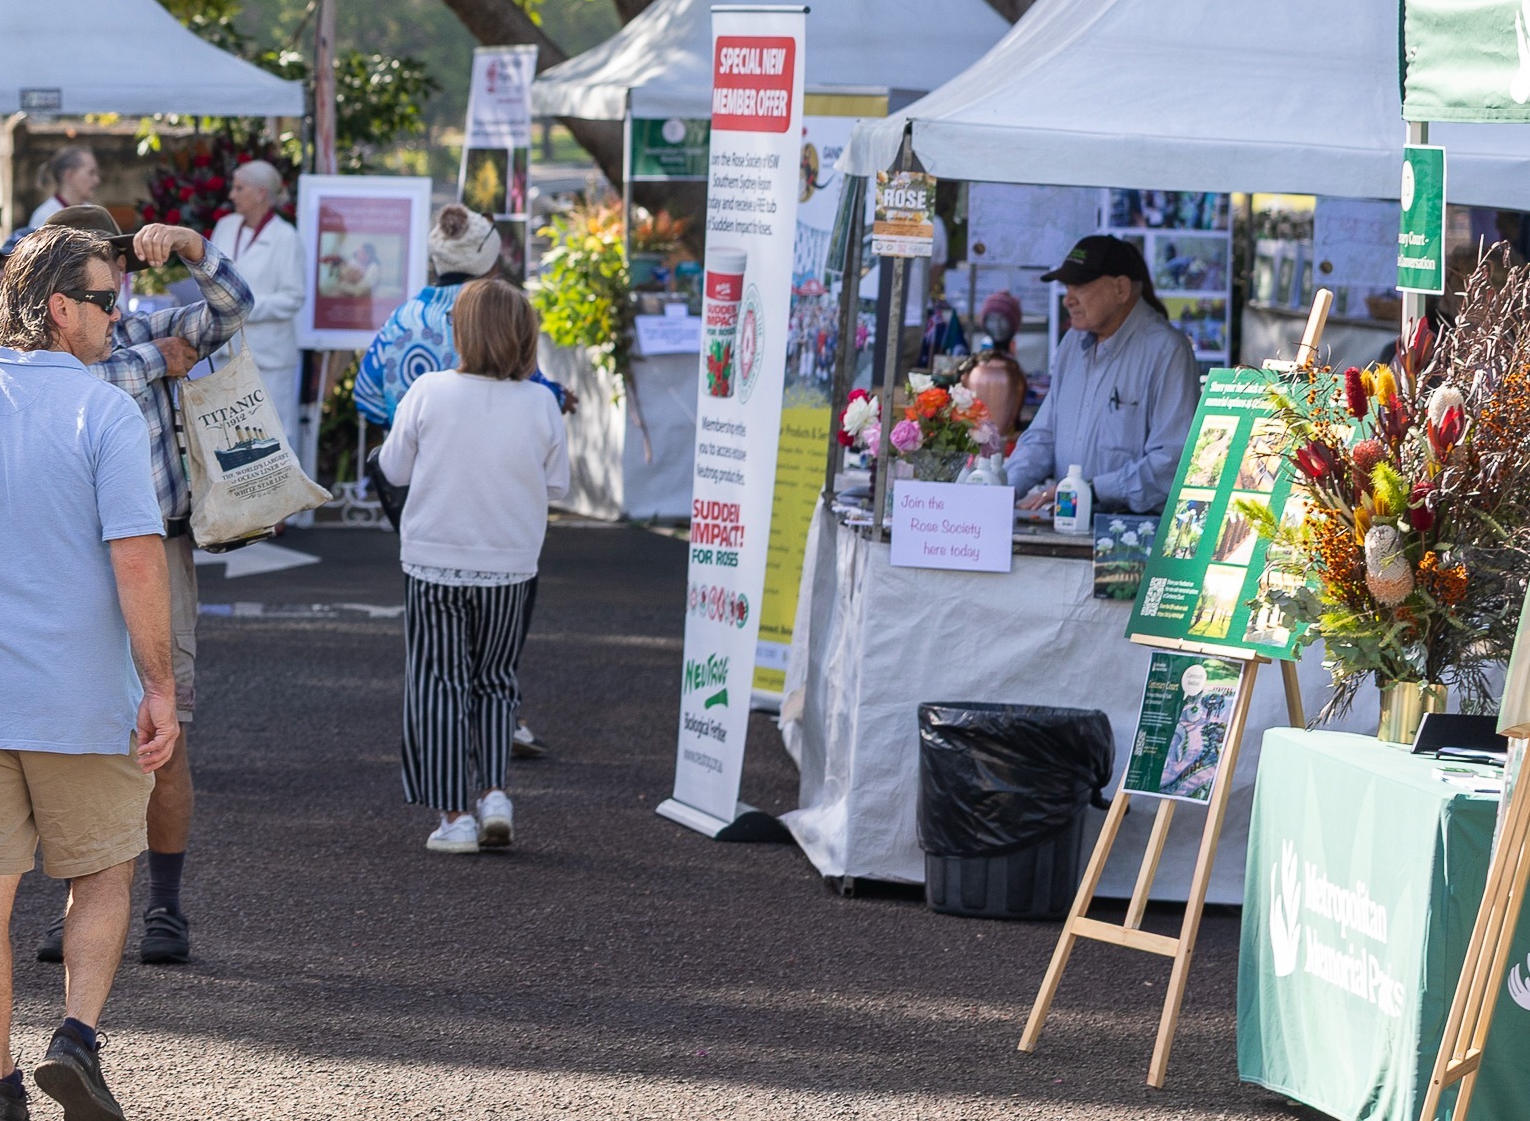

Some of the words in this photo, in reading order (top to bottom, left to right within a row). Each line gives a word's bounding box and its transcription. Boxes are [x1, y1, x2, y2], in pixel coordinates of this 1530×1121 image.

[719, 47, 761, 75] SPECIAL
[762, 47, 787, 76] NEW
[712, 87, 757, 117] MEMBER
[757, 88, 788, 118] OFFER
[721, 152, 731, 167] the
[732, 152, 745, 168] Rose
[712, 172, 738, 189] Southern
[722, 196, 734, 211] and
[884, 188, 927, 210] ROSE
[711, 216, 734, 232] Sudden
[1409, 231, 1425, 246] Court
[198, 389, 265, 427] TITANIC
[226, 413, 247, 428] 1912
[222, 473, 234, 481] THE
[235, 464, 263, 476] WORLD'S
[264, 452, 289, 467] LARGEST
[237, 471, 260, 483] OCEAN
[260, 463, 280, 475] LINER
[234, 485, 257, 497] WHITE
[257, 479, 274, 490] STAR
[274, 472, 290, 484] LINE
[693, 498, 740, 524] SUDDEN
[900, 494, 925, 510] Join
[928, 495, 945, 510] the
[691, 522, 745, 548] IMPACT!
[910, 517, 939, 533] Rose
[941, 518, 982, 539] Society
[692, 548, 713, 565] FOR
[923, 541, 947, 556] here
[950, 543, 980, 563] today
[1166, 681, 1179, 691] Court
[1304, 860, 1388, 944] Metropolitan
[1304, 924, 1368, 1000] Memorial
